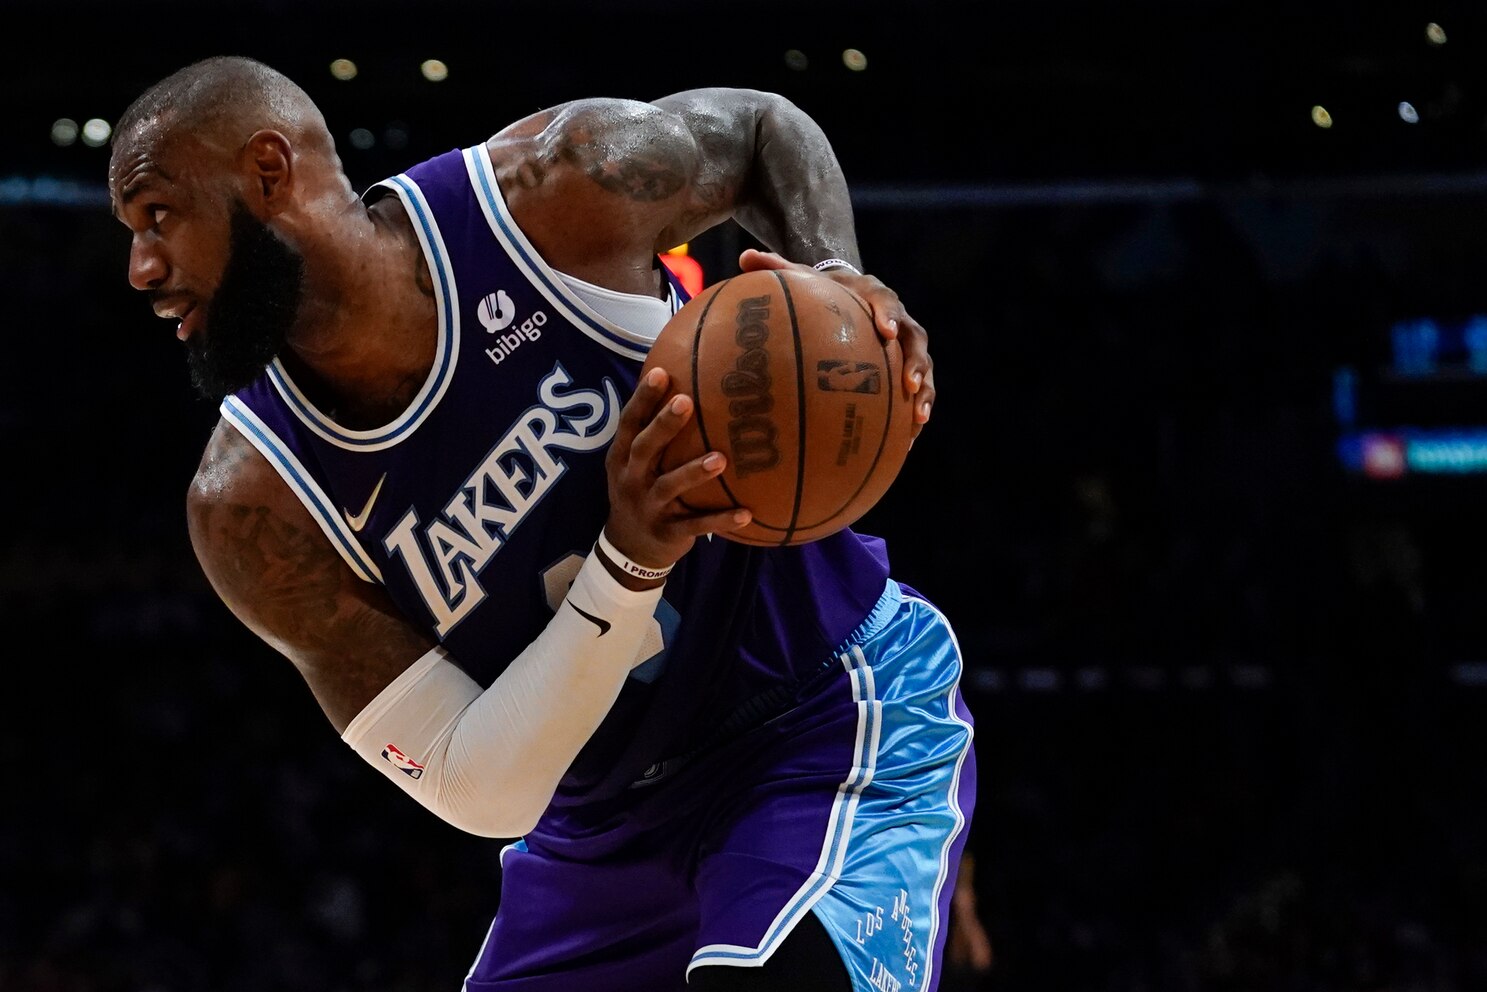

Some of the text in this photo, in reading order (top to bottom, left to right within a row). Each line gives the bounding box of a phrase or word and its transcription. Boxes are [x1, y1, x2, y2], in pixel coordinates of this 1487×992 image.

[485, 310, 548, 365] bibigo
[721, 294, 783, 479] Wilson
[381, 359, 621, 642] LAKERS
[856, 906, 884, 945] LOS
